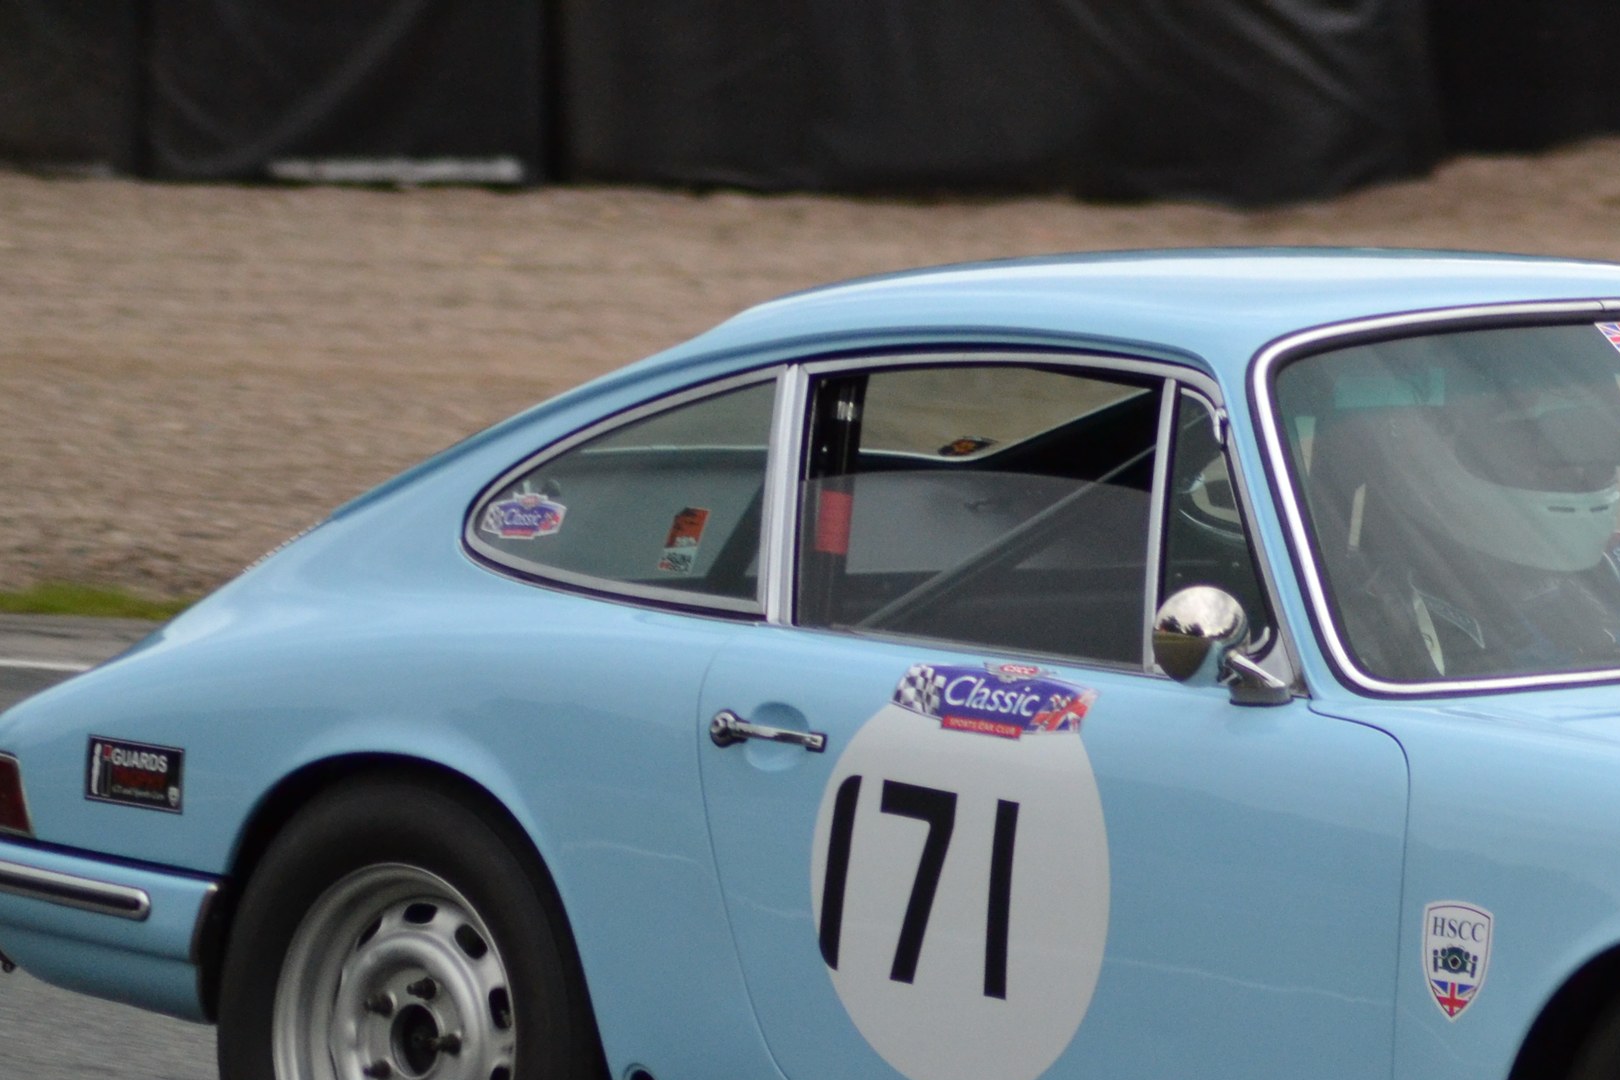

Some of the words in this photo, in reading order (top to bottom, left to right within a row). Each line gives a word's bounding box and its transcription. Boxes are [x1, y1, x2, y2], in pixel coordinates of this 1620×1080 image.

[944, 675, 1040, 717] Classic
[111, 747, 168, 773] GUARDS
[819, 775, 1020, 1000] 171
[1433, 916, 1485, 942] HSCC
